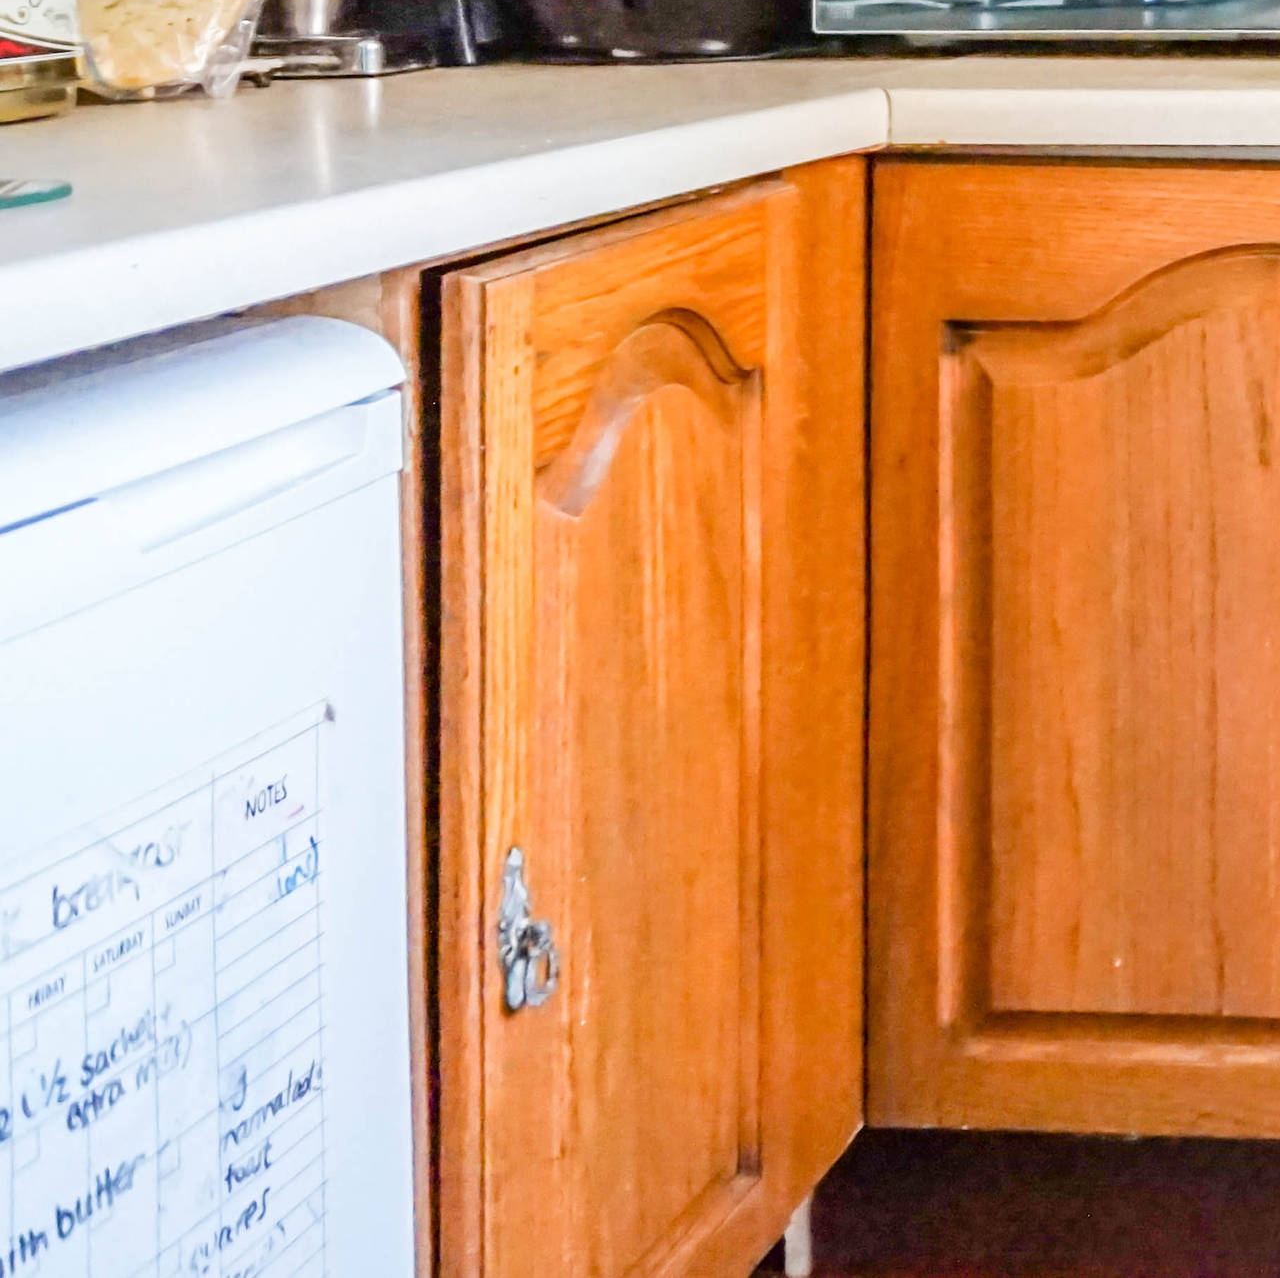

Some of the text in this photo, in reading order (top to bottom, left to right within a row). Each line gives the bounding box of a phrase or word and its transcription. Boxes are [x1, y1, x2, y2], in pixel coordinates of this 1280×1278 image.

[245, 774, 288, 821] NOTES
[93, 930, 144, 972] SATURDAY
[28, 975, 66, 1010] FRIDAY
